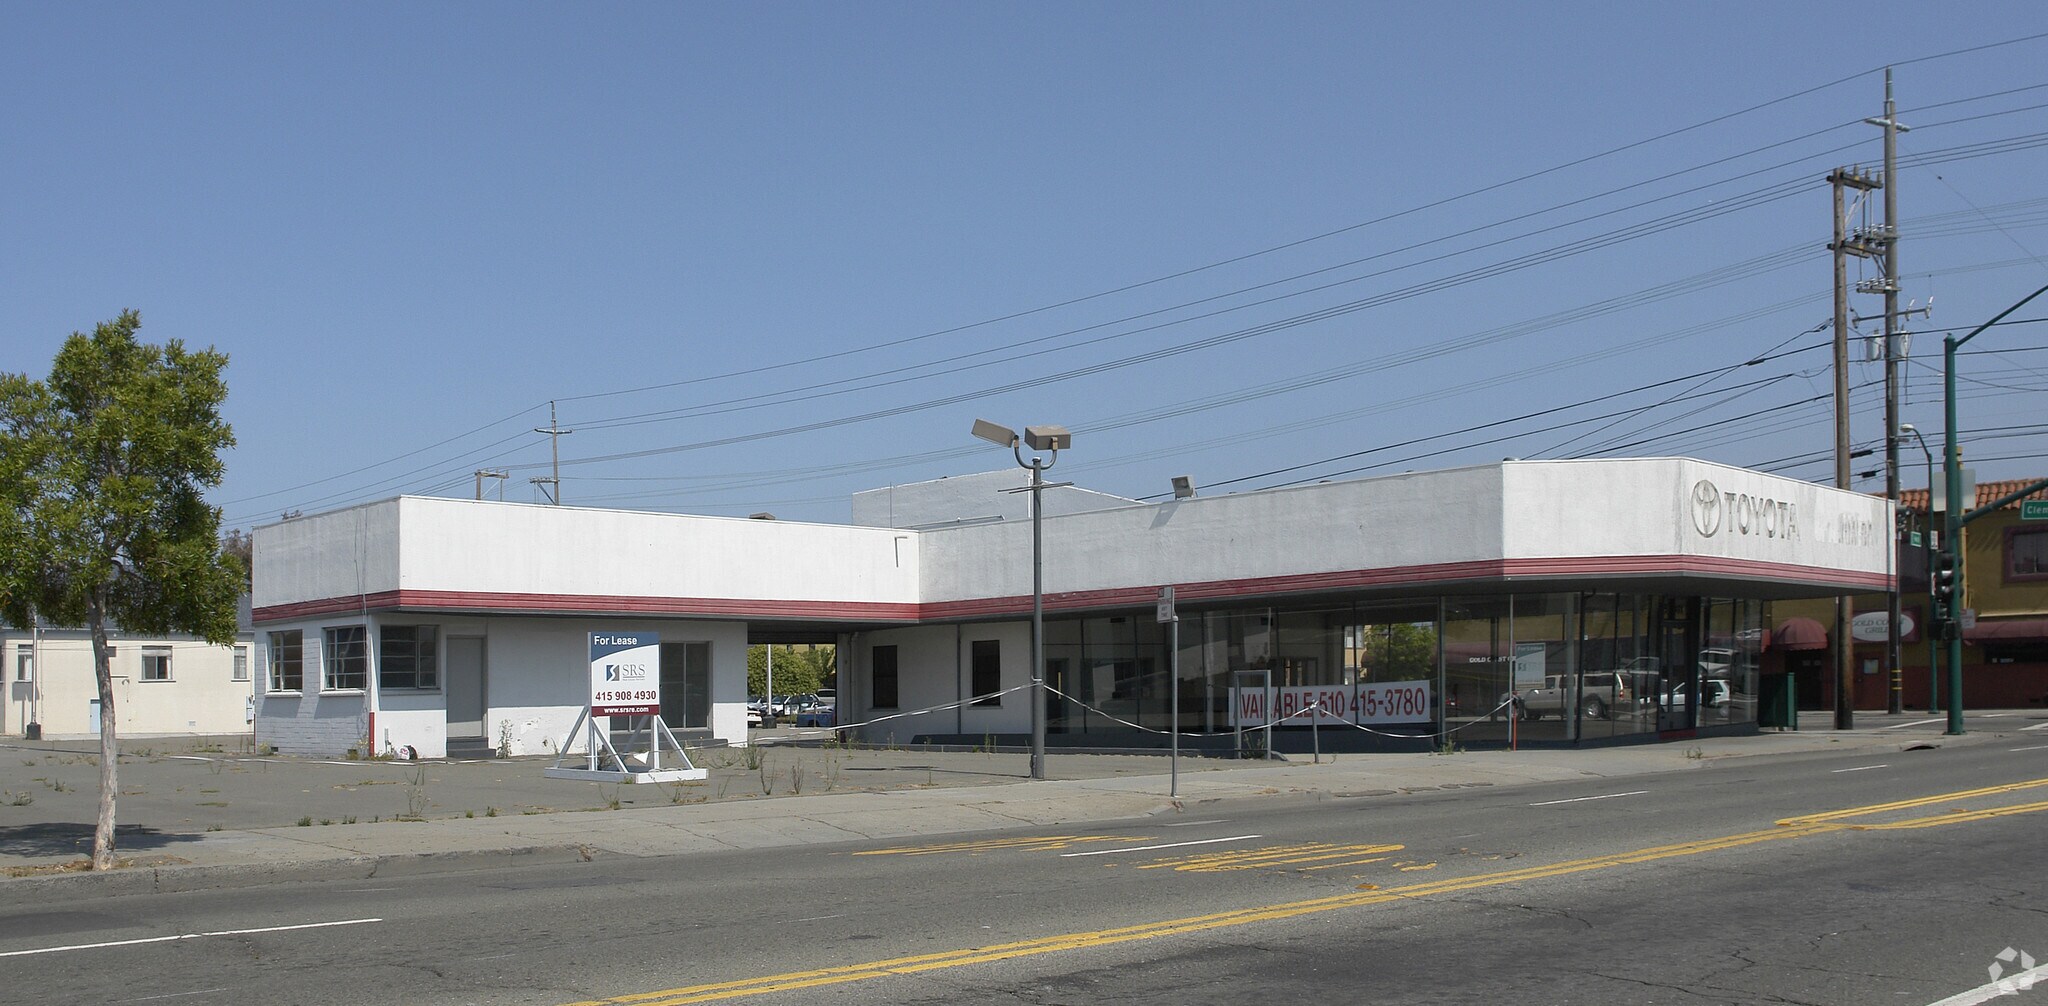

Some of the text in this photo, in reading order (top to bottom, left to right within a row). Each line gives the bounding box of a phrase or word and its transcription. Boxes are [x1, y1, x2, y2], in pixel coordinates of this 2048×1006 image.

[1724, 491, 1800, 541] TOYOTA
[594, 635, 637, 645] For Lease
[622, 664, 646, 676] SRS
[595, 690, 657, 701] 415 908 4930
[1319, 691, 1345, 718] 510
[1349, 687, 1425, 717] 415-3780
